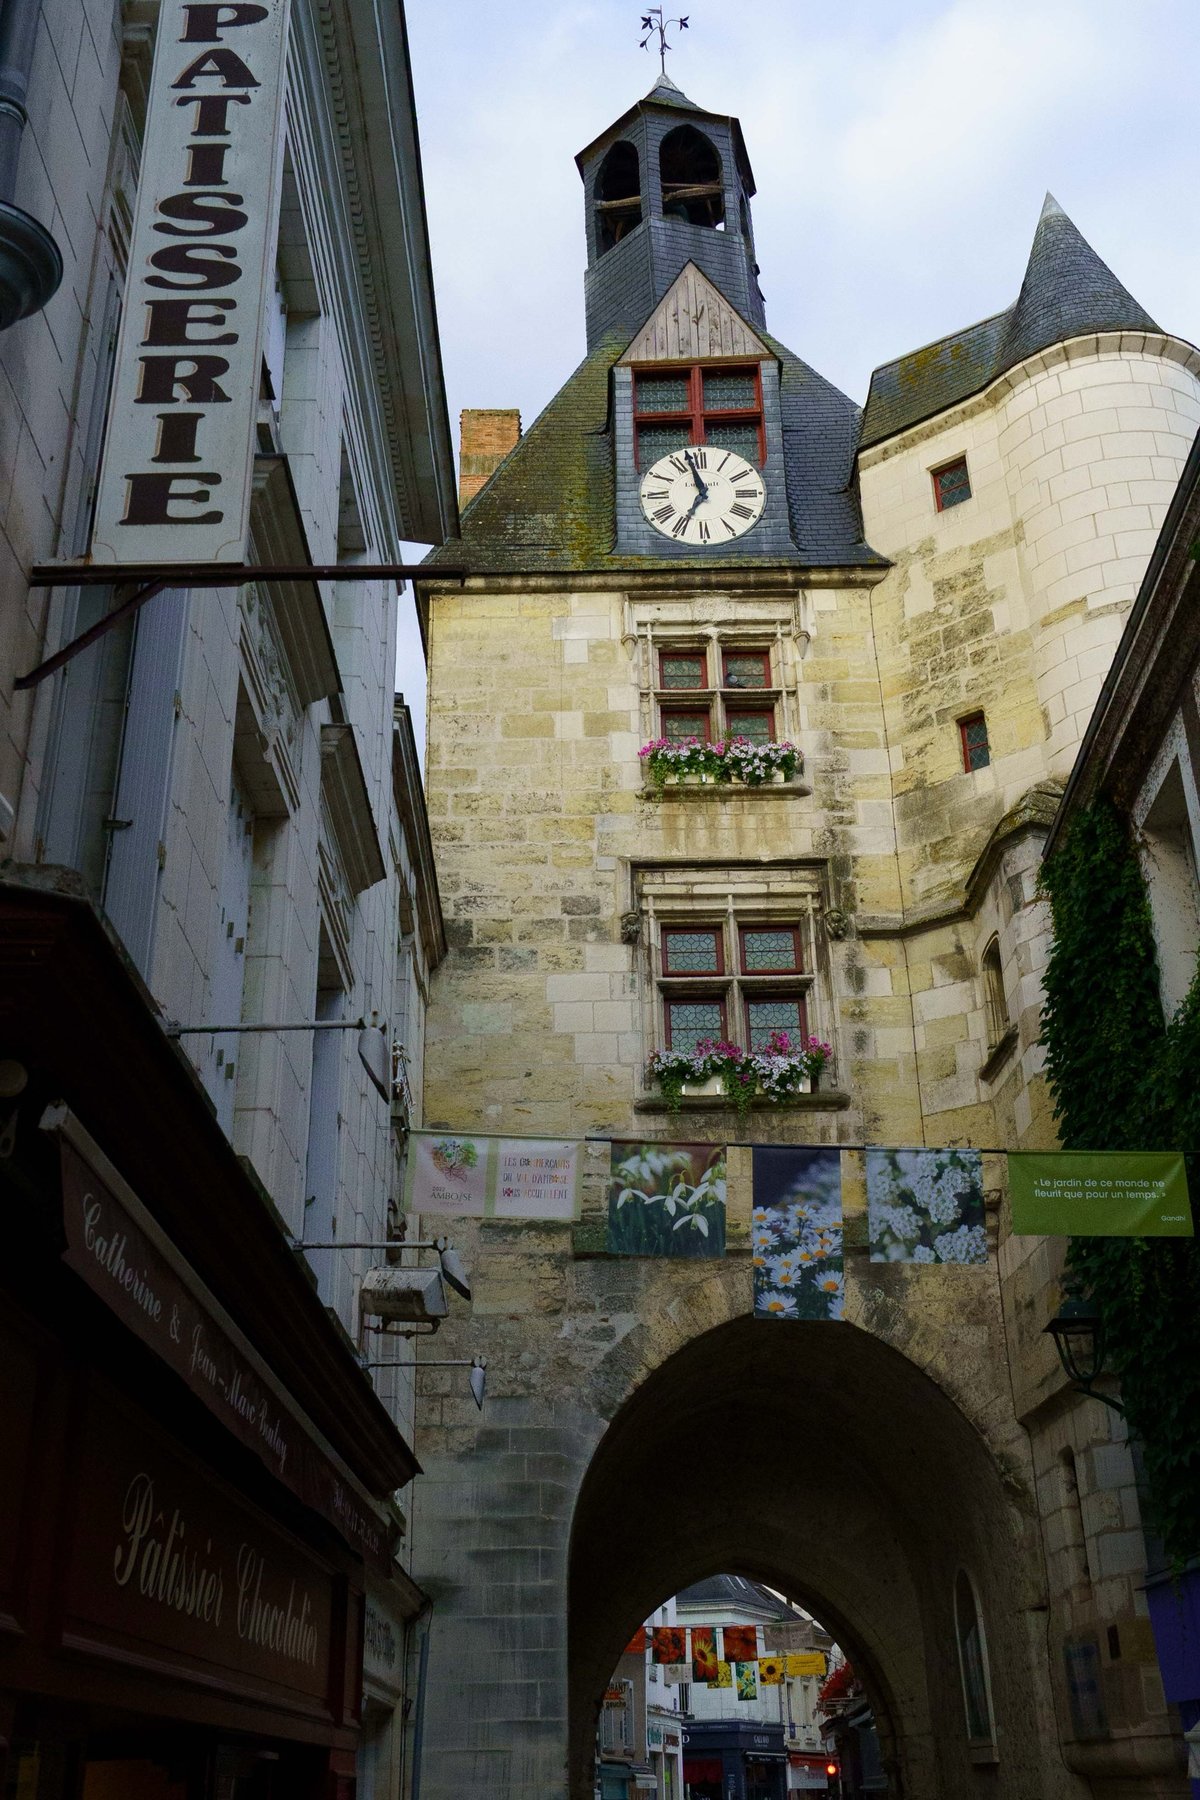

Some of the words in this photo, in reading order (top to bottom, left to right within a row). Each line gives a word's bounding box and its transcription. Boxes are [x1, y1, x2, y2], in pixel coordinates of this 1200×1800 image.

[119, 3, 269, 525] PATISSERIE
[735, 489, 757, 498] III
[1039, 1179, 1051, 1187] Le
[1053, 1179, 1081, 1189] jardin
[1084, 1179, 1097, 1187] de
[1115, 1179, 1150, 1188] monde
[1152, 1180, 1165, 1188] ne
[430, 1192, 472, 1202] AMBOISE
[1034, 1189, 1061, 1198] fleurit
[1063, 1191, 1083, 1200] que
[1085, 1191, 1109, 1201] pour
[1111, 1191, 1123, 1199] un
[1126, 1191, 1159, 1202] temps.
[82, 1191, 162, 1323] Catherine
[168, 1303, 181, 1344] &
[189, 1324, 256, 1424] Jean-Marc
[113, 1471, 225, 1629] Pâtissier
[235, 1542, 319, 1668] Chocolatier
